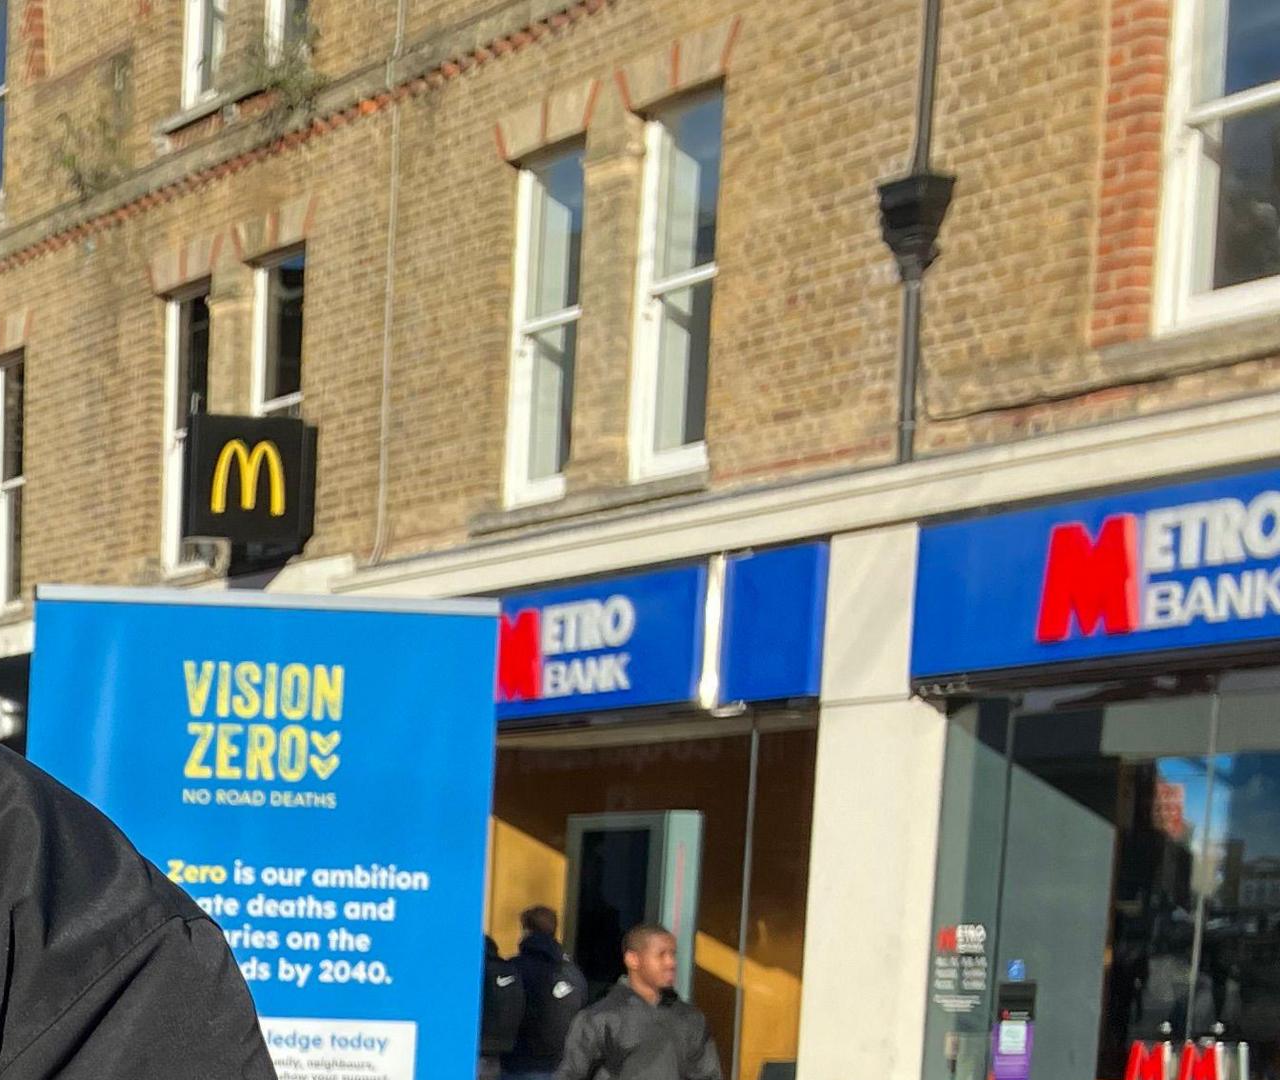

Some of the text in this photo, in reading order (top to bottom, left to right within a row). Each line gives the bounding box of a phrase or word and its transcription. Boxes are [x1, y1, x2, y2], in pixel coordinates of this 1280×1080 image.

[1036, 490, 1280, 643] METRO
[1144, 566, 1280, 632] BANK
[495, 594, 636, 703] METRO
[183, 660, 345, 721] VISION
[542, 652, 631, 698] BANK
[183, 722, 308, 782] ZERO
[182, 788, 338, 809] NO ROAD DEATHS
[167, 859, 429, 891] Zero is our ambition
[197, 894, 397, 921] ate deaths and
[286, 930, 320, 951] on
[327, 928, 372, 953] the
[277, 957, 312, 988] by
[318, 958, 393, 985] 2040.
[268, 1029, 388, 1056] ledge today
